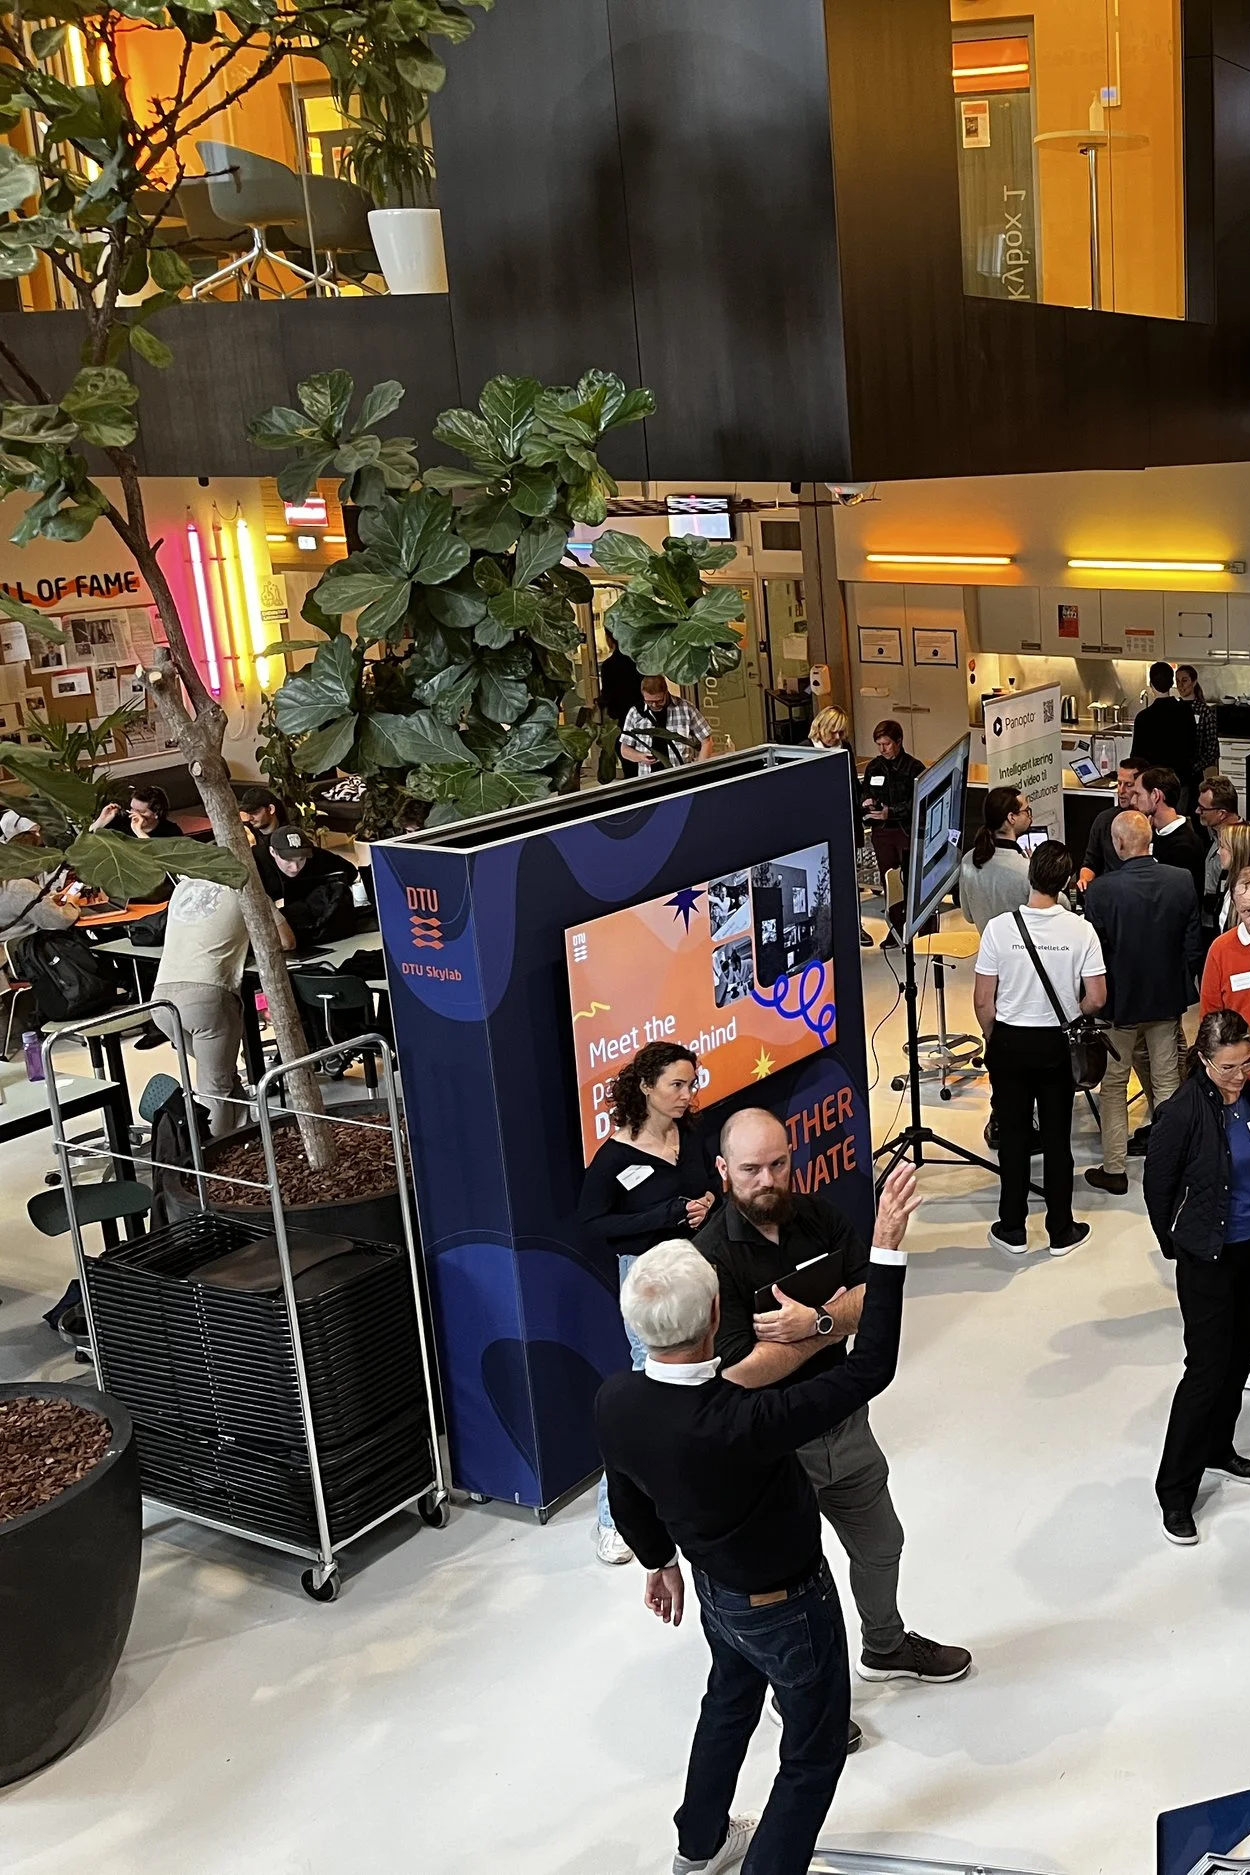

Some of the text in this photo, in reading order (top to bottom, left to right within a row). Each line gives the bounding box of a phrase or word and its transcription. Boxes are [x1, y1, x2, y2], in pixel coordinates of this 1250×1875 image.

[36, 577, 68, 602] OF
[75, 571, 138, 598] FAME
[1005, 712, 1035, 730] Panopto
[999, 759, 1032, 780] Intelligent
[1023, 773, 1041, 788] video
[406, 886, 439, 913] DTU
[573, 932, 586, 945] DTU
[402, 962, 462, 981] DTU Skylab
[589, 1013, 676, 1069] Meet the
[678, 1016, 737, 1056] ehind
[792, 1134, 857, 1195] VATE
